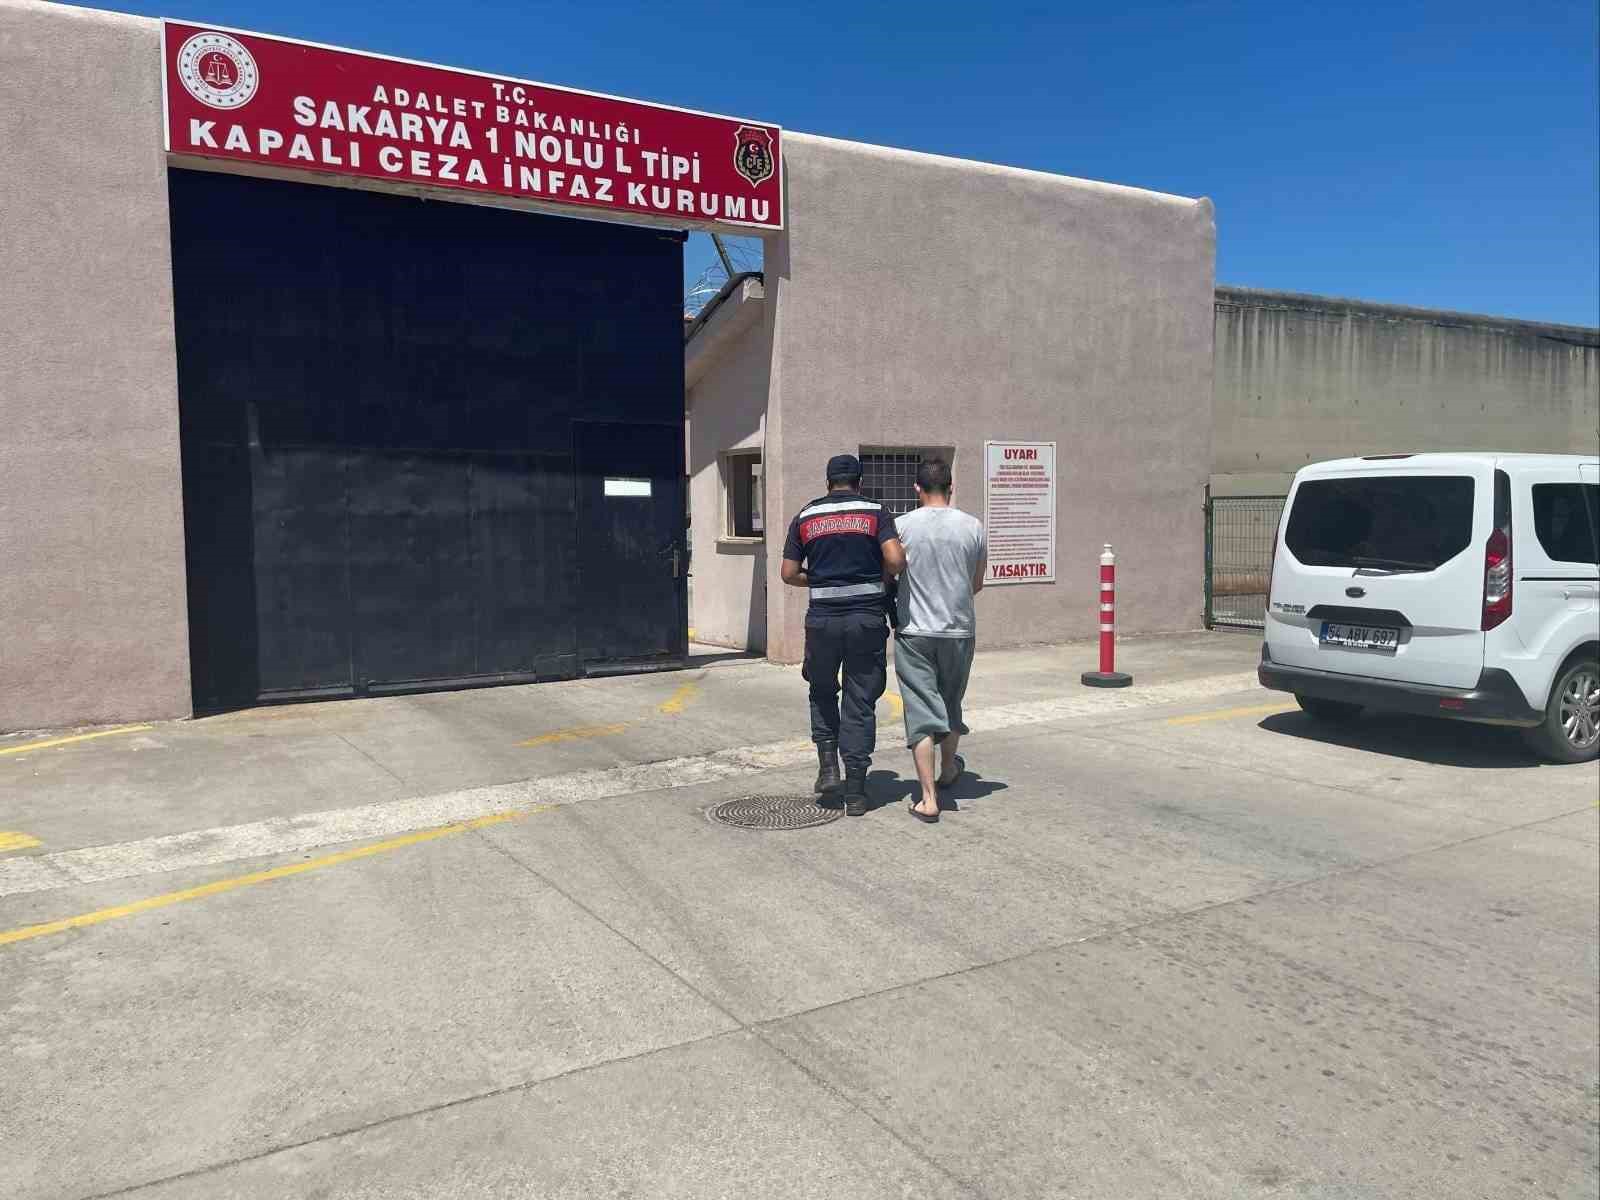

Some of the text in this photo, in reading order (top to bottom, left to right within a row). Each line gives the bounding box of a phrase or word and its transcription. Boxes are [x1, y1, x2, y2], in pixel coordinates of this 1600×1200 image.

[492, 83, 534, 105] T.C.
[373, 85, 640, 144] ADALET BAKANLIĞI
[293, 95, 700, 183] SAKARYA 1 NOLU L TİPİ
[190, 119, 769, 221] KAPALI CEZA İNFAZ KURUMU
[1004, 449, 1037, 460] UYARI
[807, 517, 870, 537] JANDARMA
[992, 563, 1047, 577] YASAKTIR
[1346, 628, 1369, 642] ABV
[1373, 630, 1395, 645] 697
